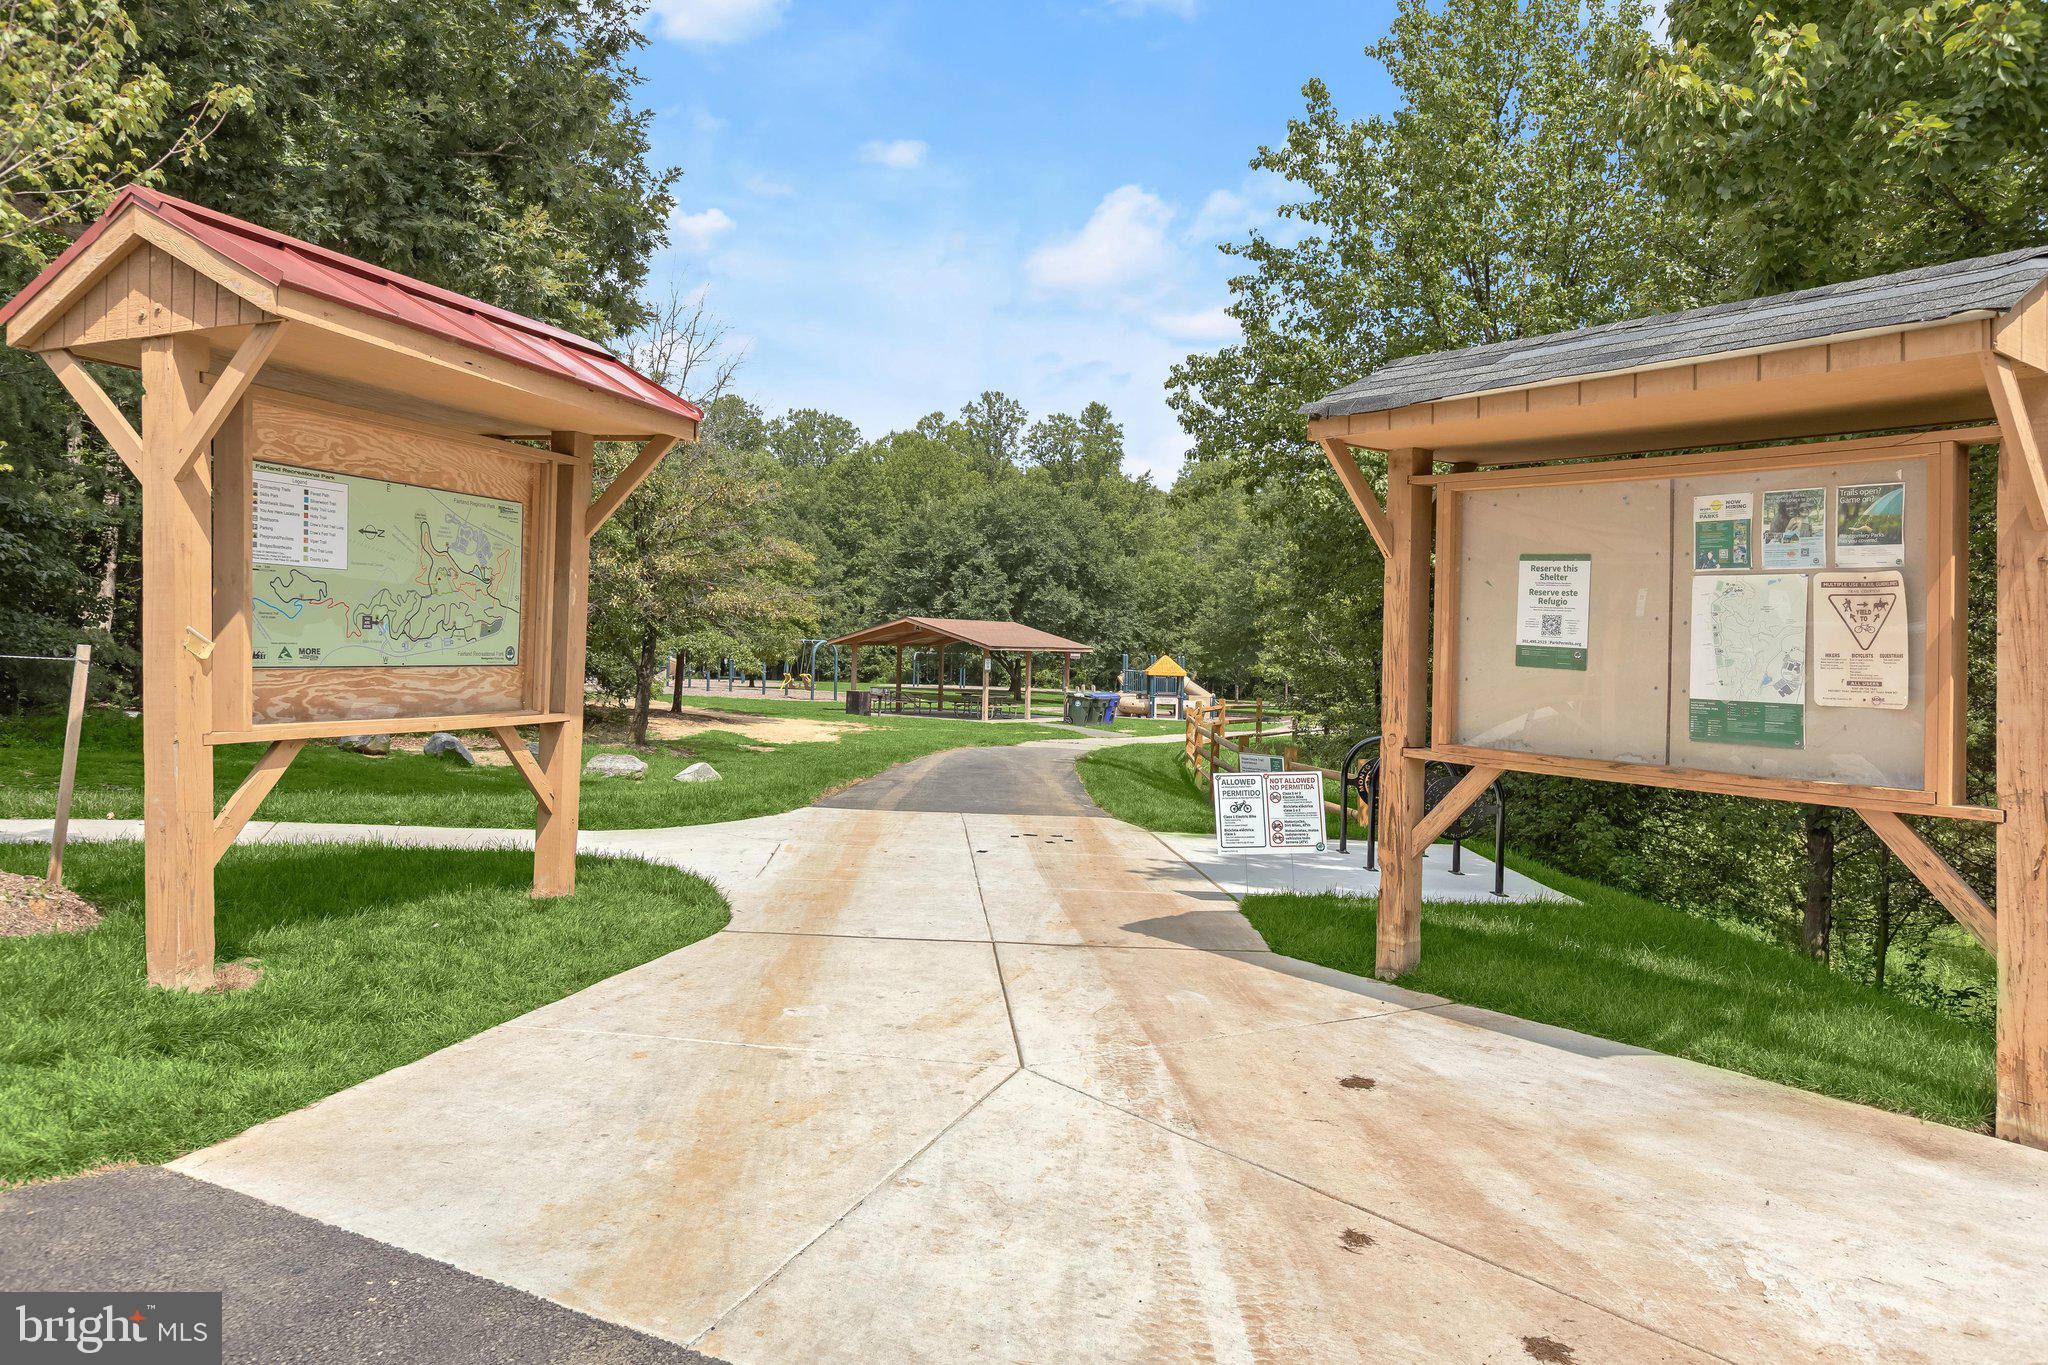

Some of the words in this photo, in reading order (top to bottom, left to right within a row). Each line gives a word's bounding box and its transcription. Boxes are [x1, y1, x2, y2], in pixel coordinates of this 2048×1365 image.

[256, 464, 280, 472] Fairland
[282, 468, 320, 478] Recreational
[1860, 488, 1881, 496] open?
[1563, 564, 1578, 572] this
[1538, 598, 1568, 606] Refugio
